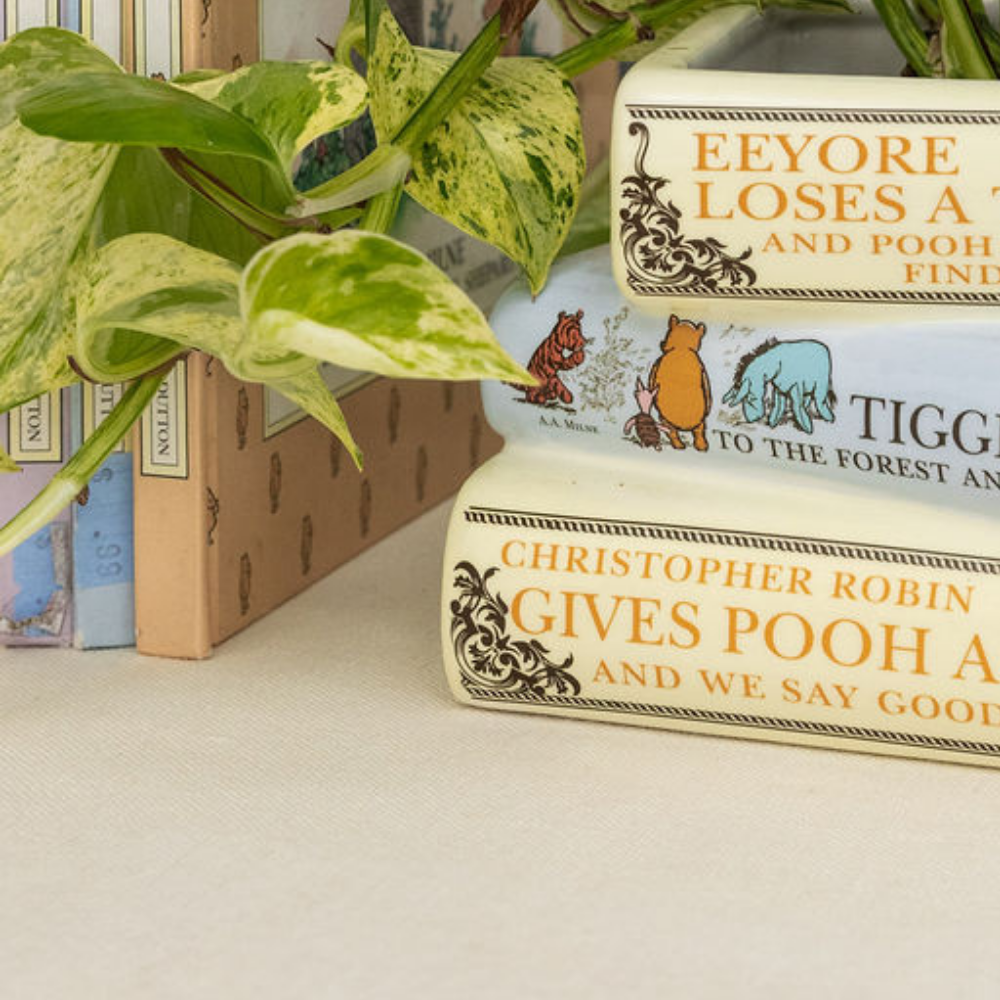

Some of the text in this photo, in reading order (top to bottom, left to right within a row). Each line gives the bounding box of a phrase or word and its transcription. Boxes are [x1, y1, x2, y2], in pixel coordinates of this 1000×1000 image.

[692, 132, 960, 175] EEYORE
[694, 181, 907, 224] LOSES
[926, 185, 974, 225] A
[761, 232, 992, 258] AND POOH
[712, 429, 753, 453] TO
[763, 437, 827, 465] THE
[835, 449, 950, 483] FOREST
[501, 539, 976, 614] CHRISTOPHER ROBIN
[510, 587, 701, 650] GIVES
[723, 606, 931, 676] POOH
[952, 634, 1000, 684] A
[593, 658, 682, 690] AND
[699, 669, 766, 699] WE
[782, 678, 858, 709] SAY
